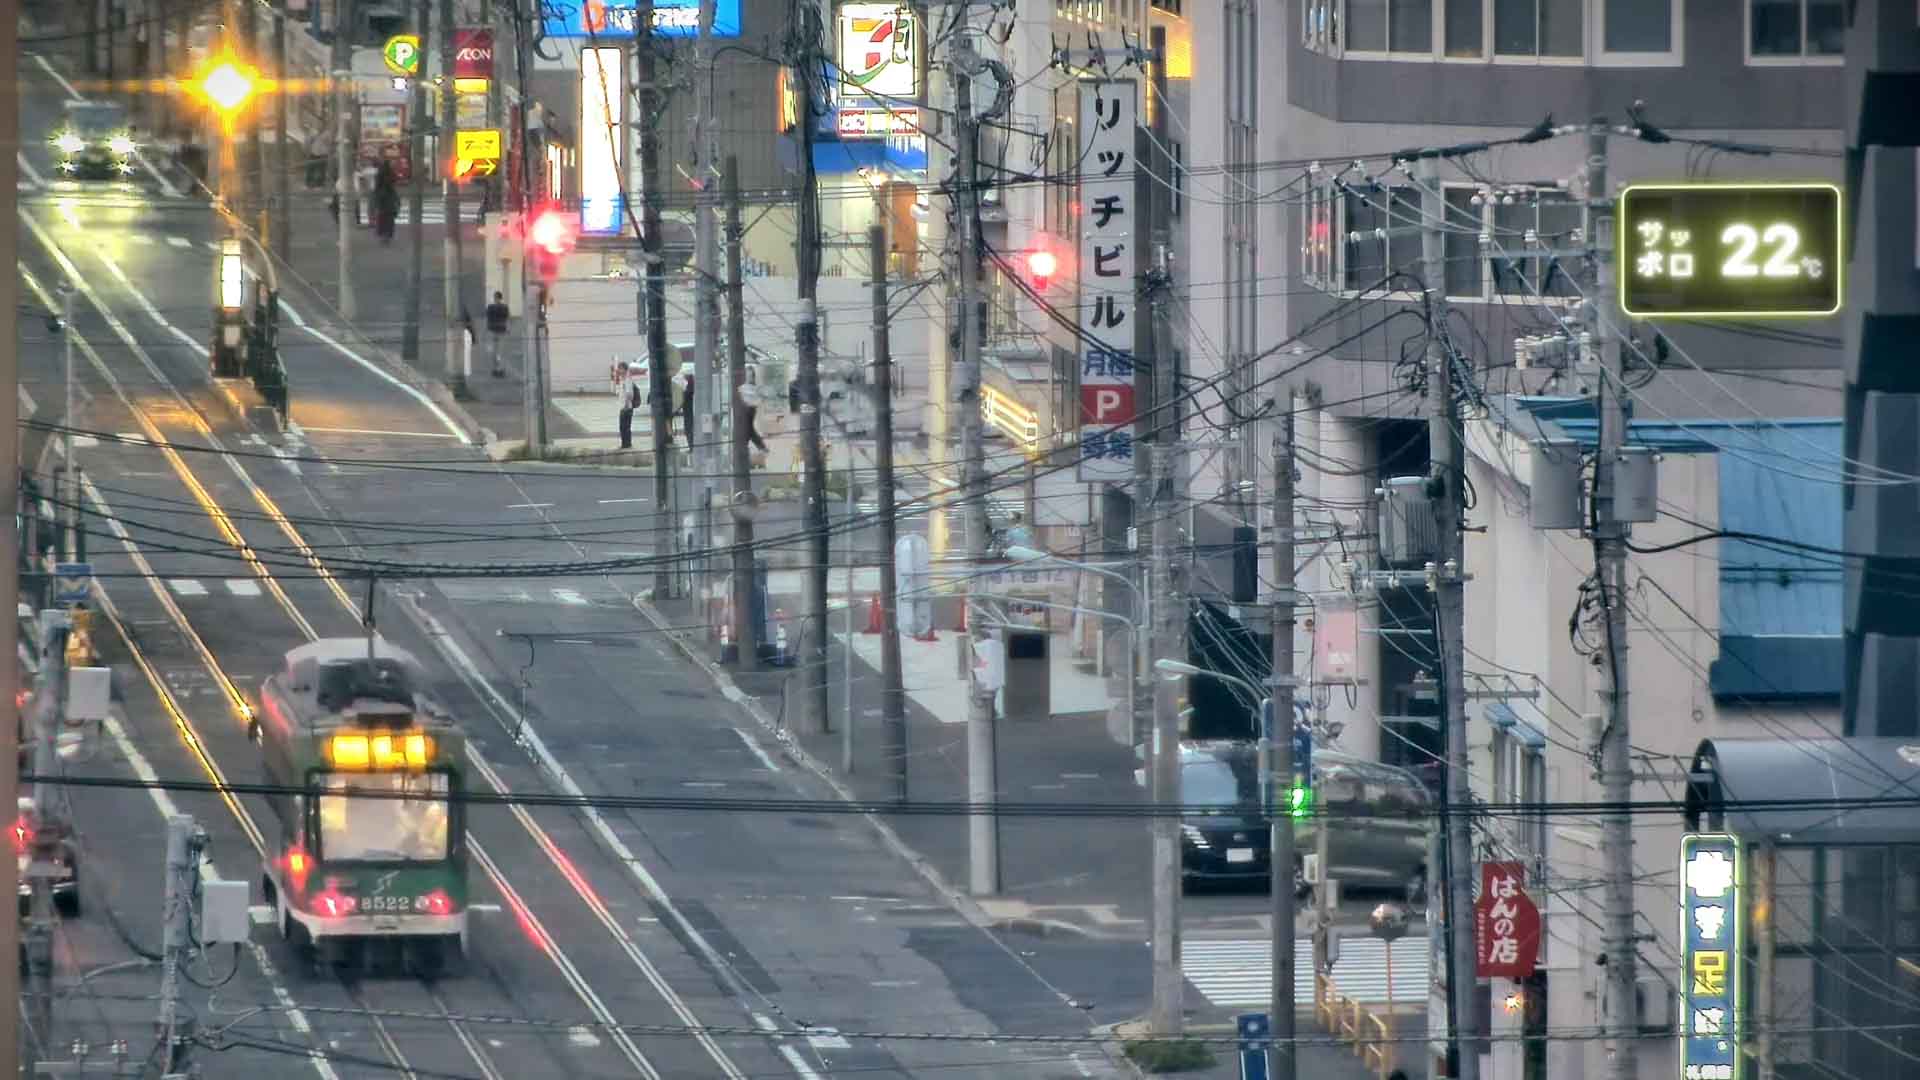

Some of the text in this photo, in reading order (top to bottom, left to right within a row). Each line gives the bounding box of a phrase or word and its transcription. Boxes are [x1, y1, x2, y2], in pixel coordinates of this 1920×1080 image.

[395, 43, 414, 66] P
[1091, 98, 1125, 328] リッチビル
[1096, 389, 1121, 419] P
[1488, 874, 1519, 964] はんの店
